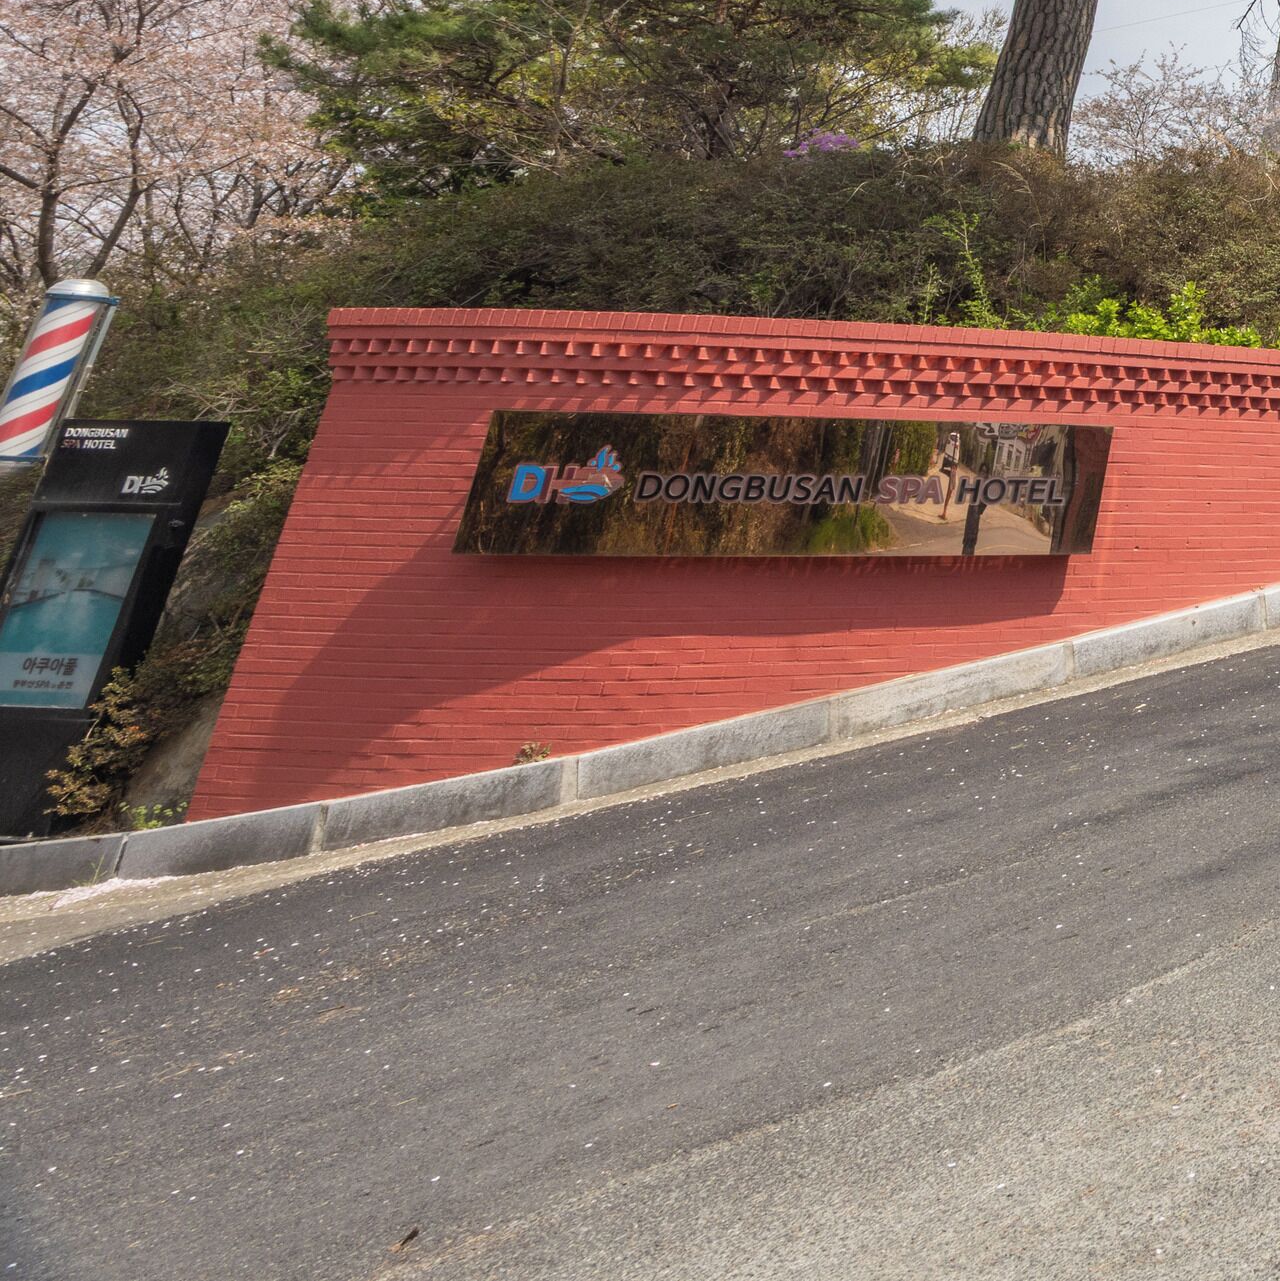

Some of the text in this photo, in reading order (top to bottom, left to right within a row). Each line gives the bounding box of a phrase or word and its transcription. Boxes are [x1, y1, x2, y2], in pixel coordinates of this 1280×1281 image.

[64, 427, 129, 438] DONGBUSAN
[60, 439, 117, 449] SPA HOTEL
[635, 470, 867, 506] DONGBUSAN
[874, 473, 945, 506] SPA
[954, 474, 1066, 507] HOTEL
[22, 656, 79, 676] 아쿠아풀
